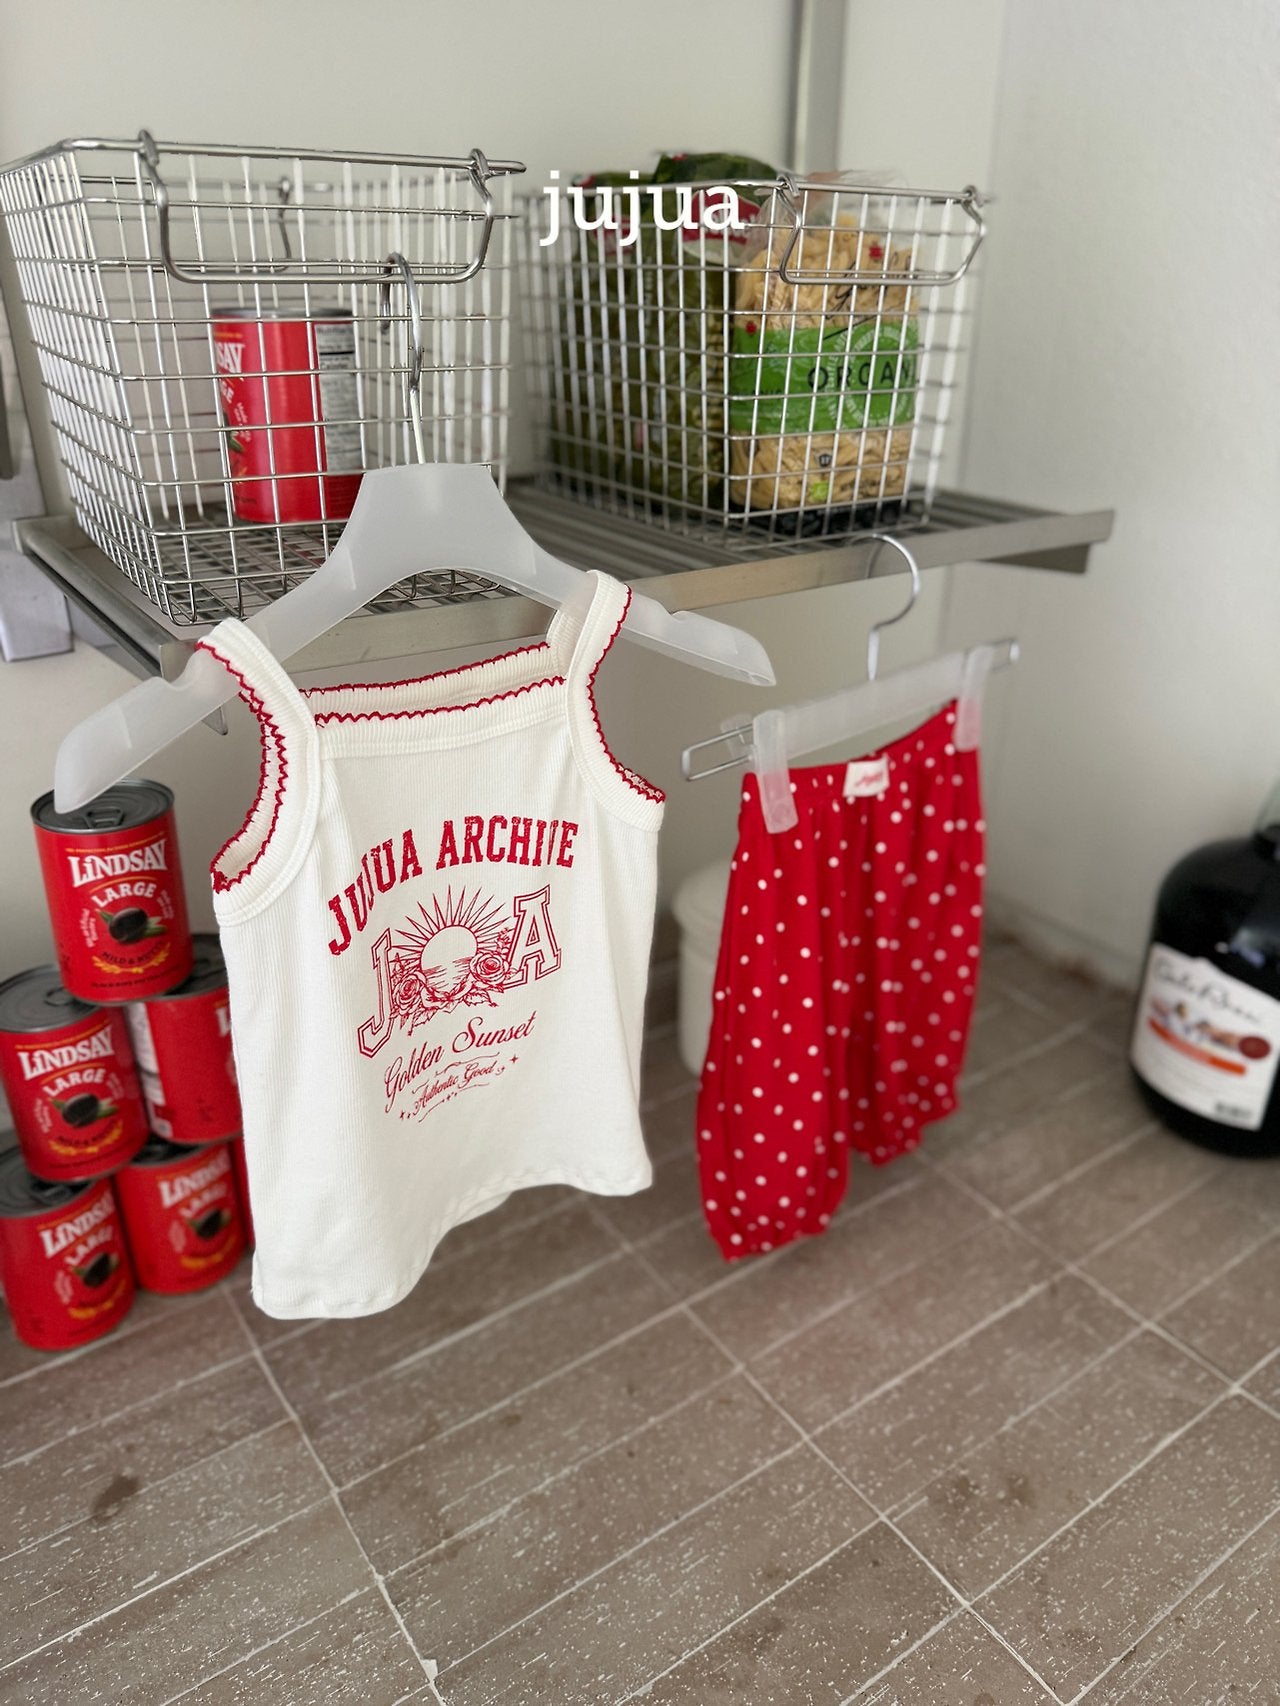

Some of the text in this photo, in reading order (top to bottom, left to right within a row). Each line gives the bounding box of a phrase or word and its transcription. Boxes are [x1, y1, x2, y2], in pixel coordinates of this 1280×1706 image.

[91, 881, 157, 908] LARGE
[384, 1010, 537, 1114] Golden Sunset
[457, 1060, 497, 1089] Good
[43, 1067, 106, 1098] LARGE
